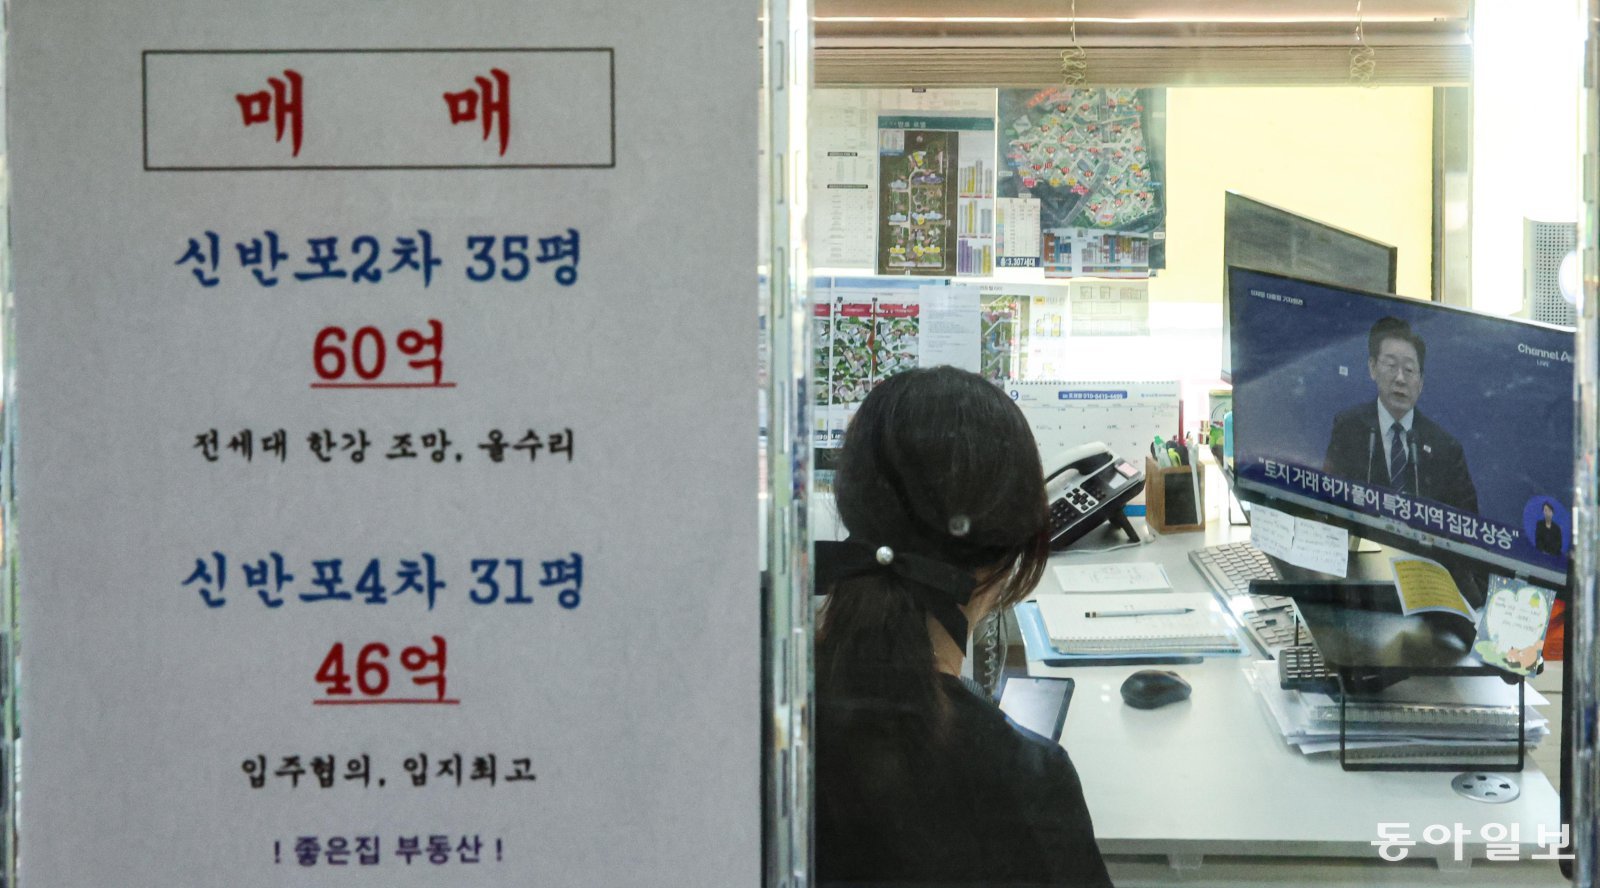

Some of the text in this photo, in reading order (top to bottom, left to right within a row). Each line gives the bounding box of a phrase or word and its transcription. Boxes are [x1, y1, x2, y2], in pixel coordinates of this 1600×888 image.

[175, 228, 580, 287] 신반포2차 35평
[313, 319, 443, 382] 60억
[1517, 343, 1560, 361] Channel
[194, 429, 286, 462] 전세대
[307, 429, 371, 463] 한강
[478, 428, 573, 463] 올수리
[1258, 457, 1519, 550] "토지 거래 허가 풀어 특정 지역 집값 상승"
[182, 551, 583, 610] 신반포4차 31평
[315, 635, 446, 698] 46억
[403, 753, 536, 787] 입지최고
[295, 836, 379, 866] 좋은집
[396, 835, 482, 865] 부동산
